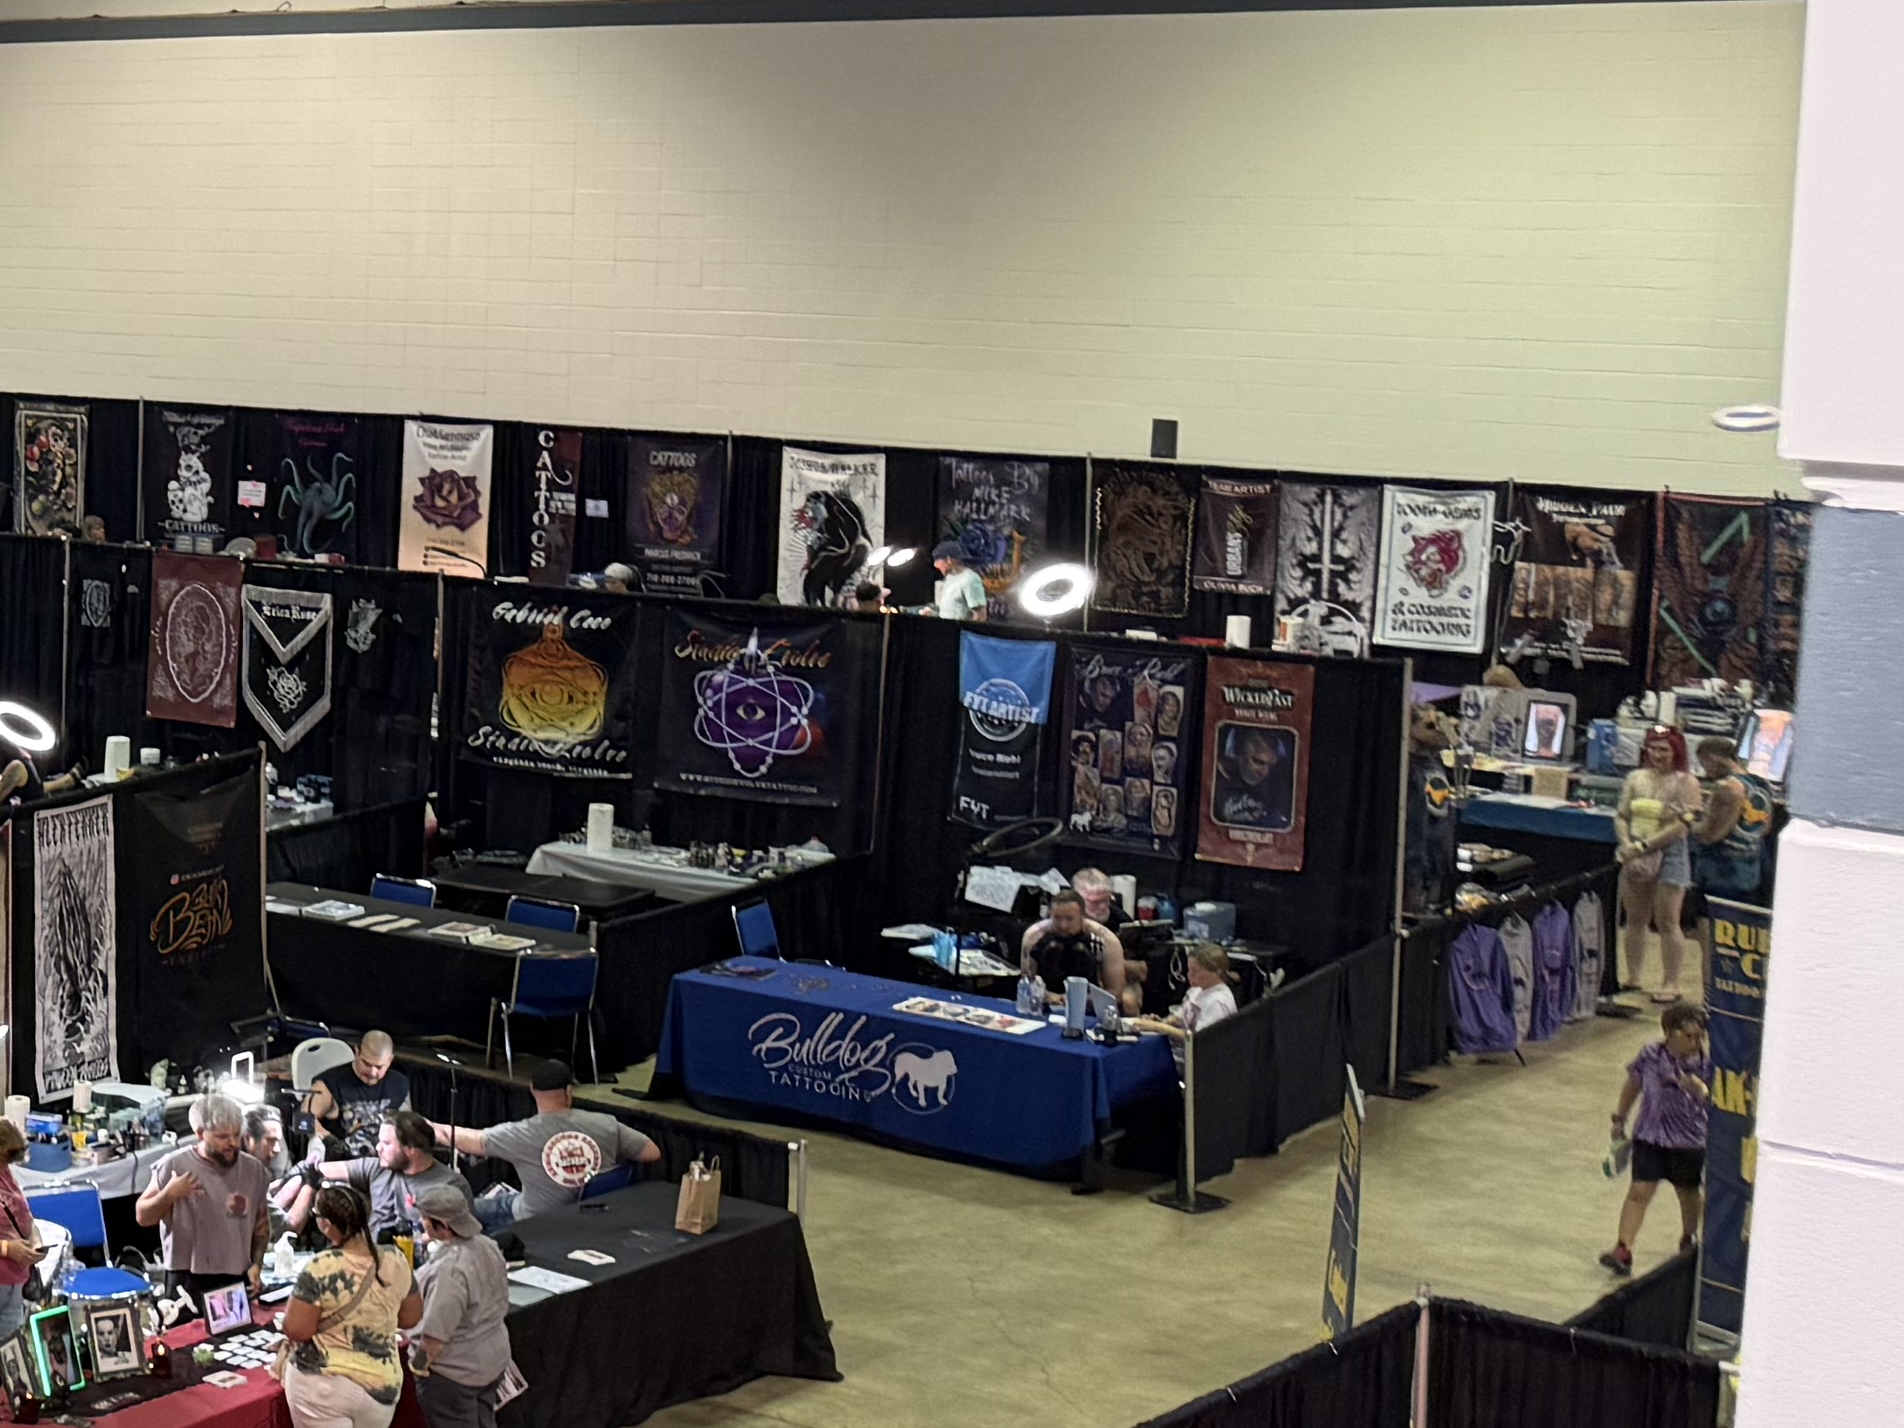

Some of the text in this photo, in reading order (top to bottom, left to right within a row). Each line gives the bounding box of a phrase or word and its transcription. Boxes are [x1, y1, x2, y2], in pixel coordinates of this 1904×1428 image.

[989, 700, 1041, 725] ARTIST
[747, 1011, 895, 1098] Bulldog
[768, 1070, 874, 1103] TATTOOING
